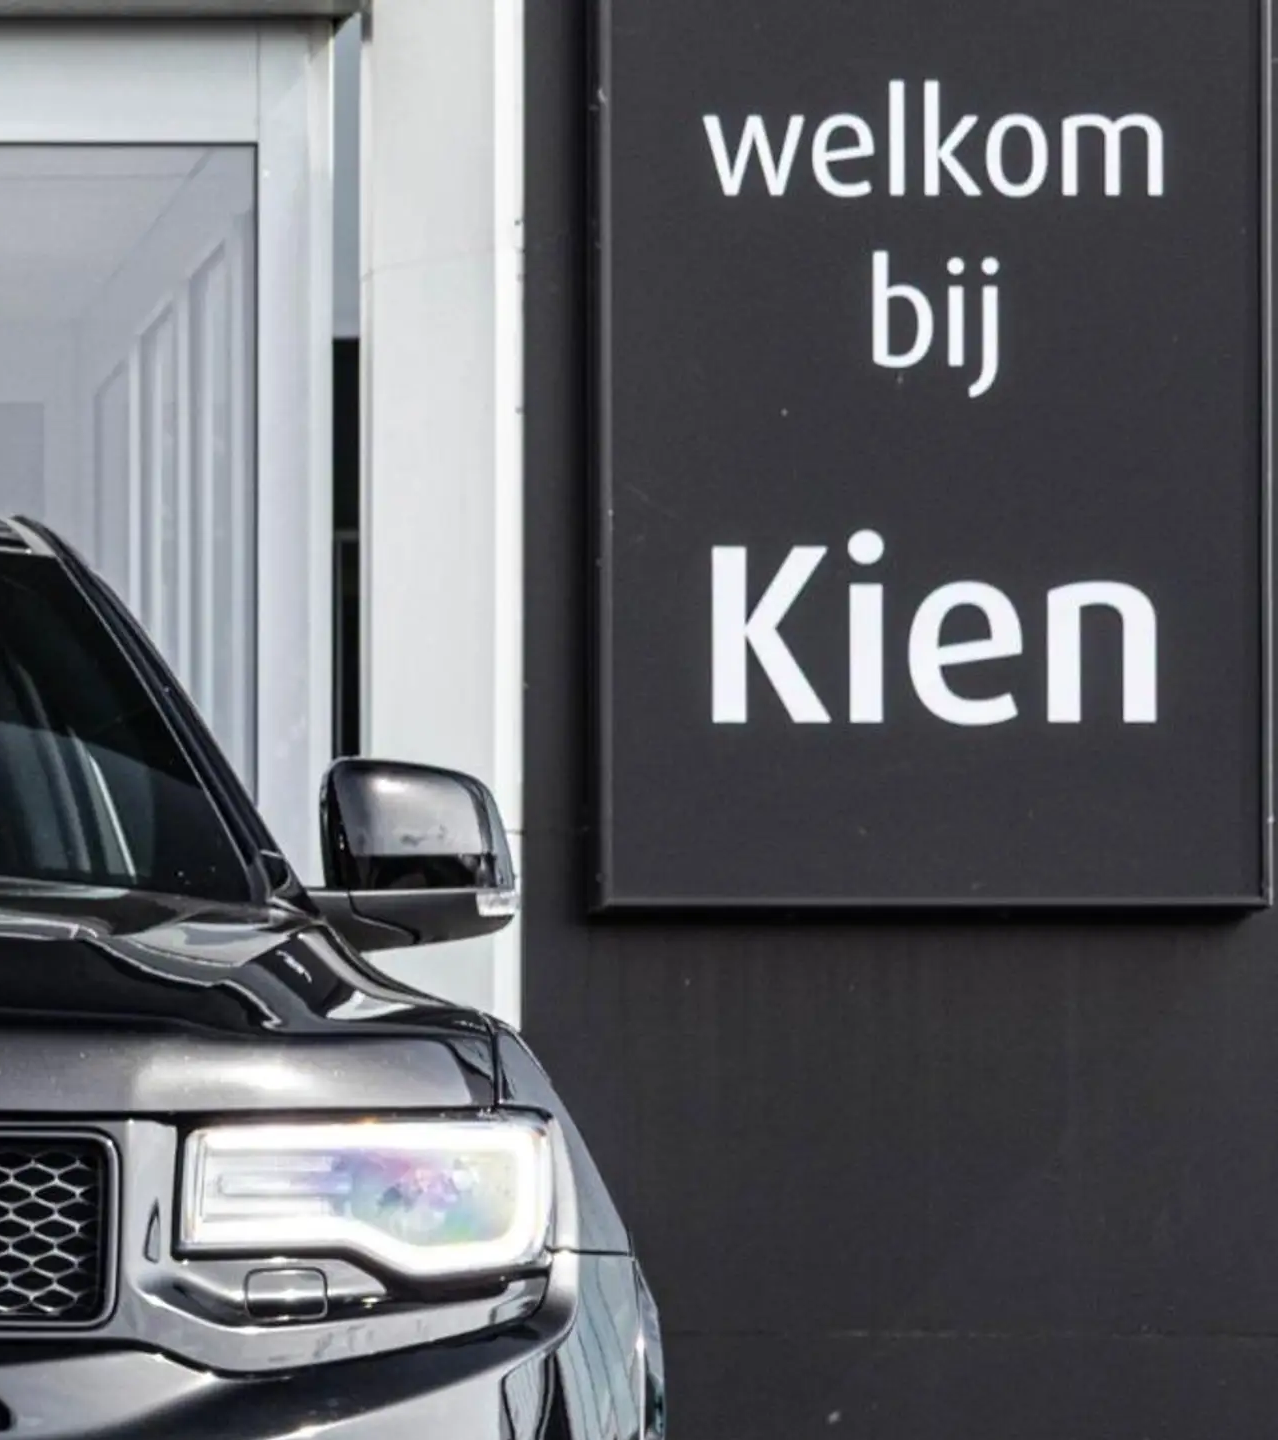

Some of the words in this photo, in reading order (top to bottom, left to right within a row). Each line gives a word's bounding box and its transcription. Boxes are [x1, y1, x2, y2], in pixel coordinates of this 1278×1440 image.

[702, 80, 1164, 197] welkom
[872, 251, 999, 398] bij
[711, 529, 1157, 726] Kien
